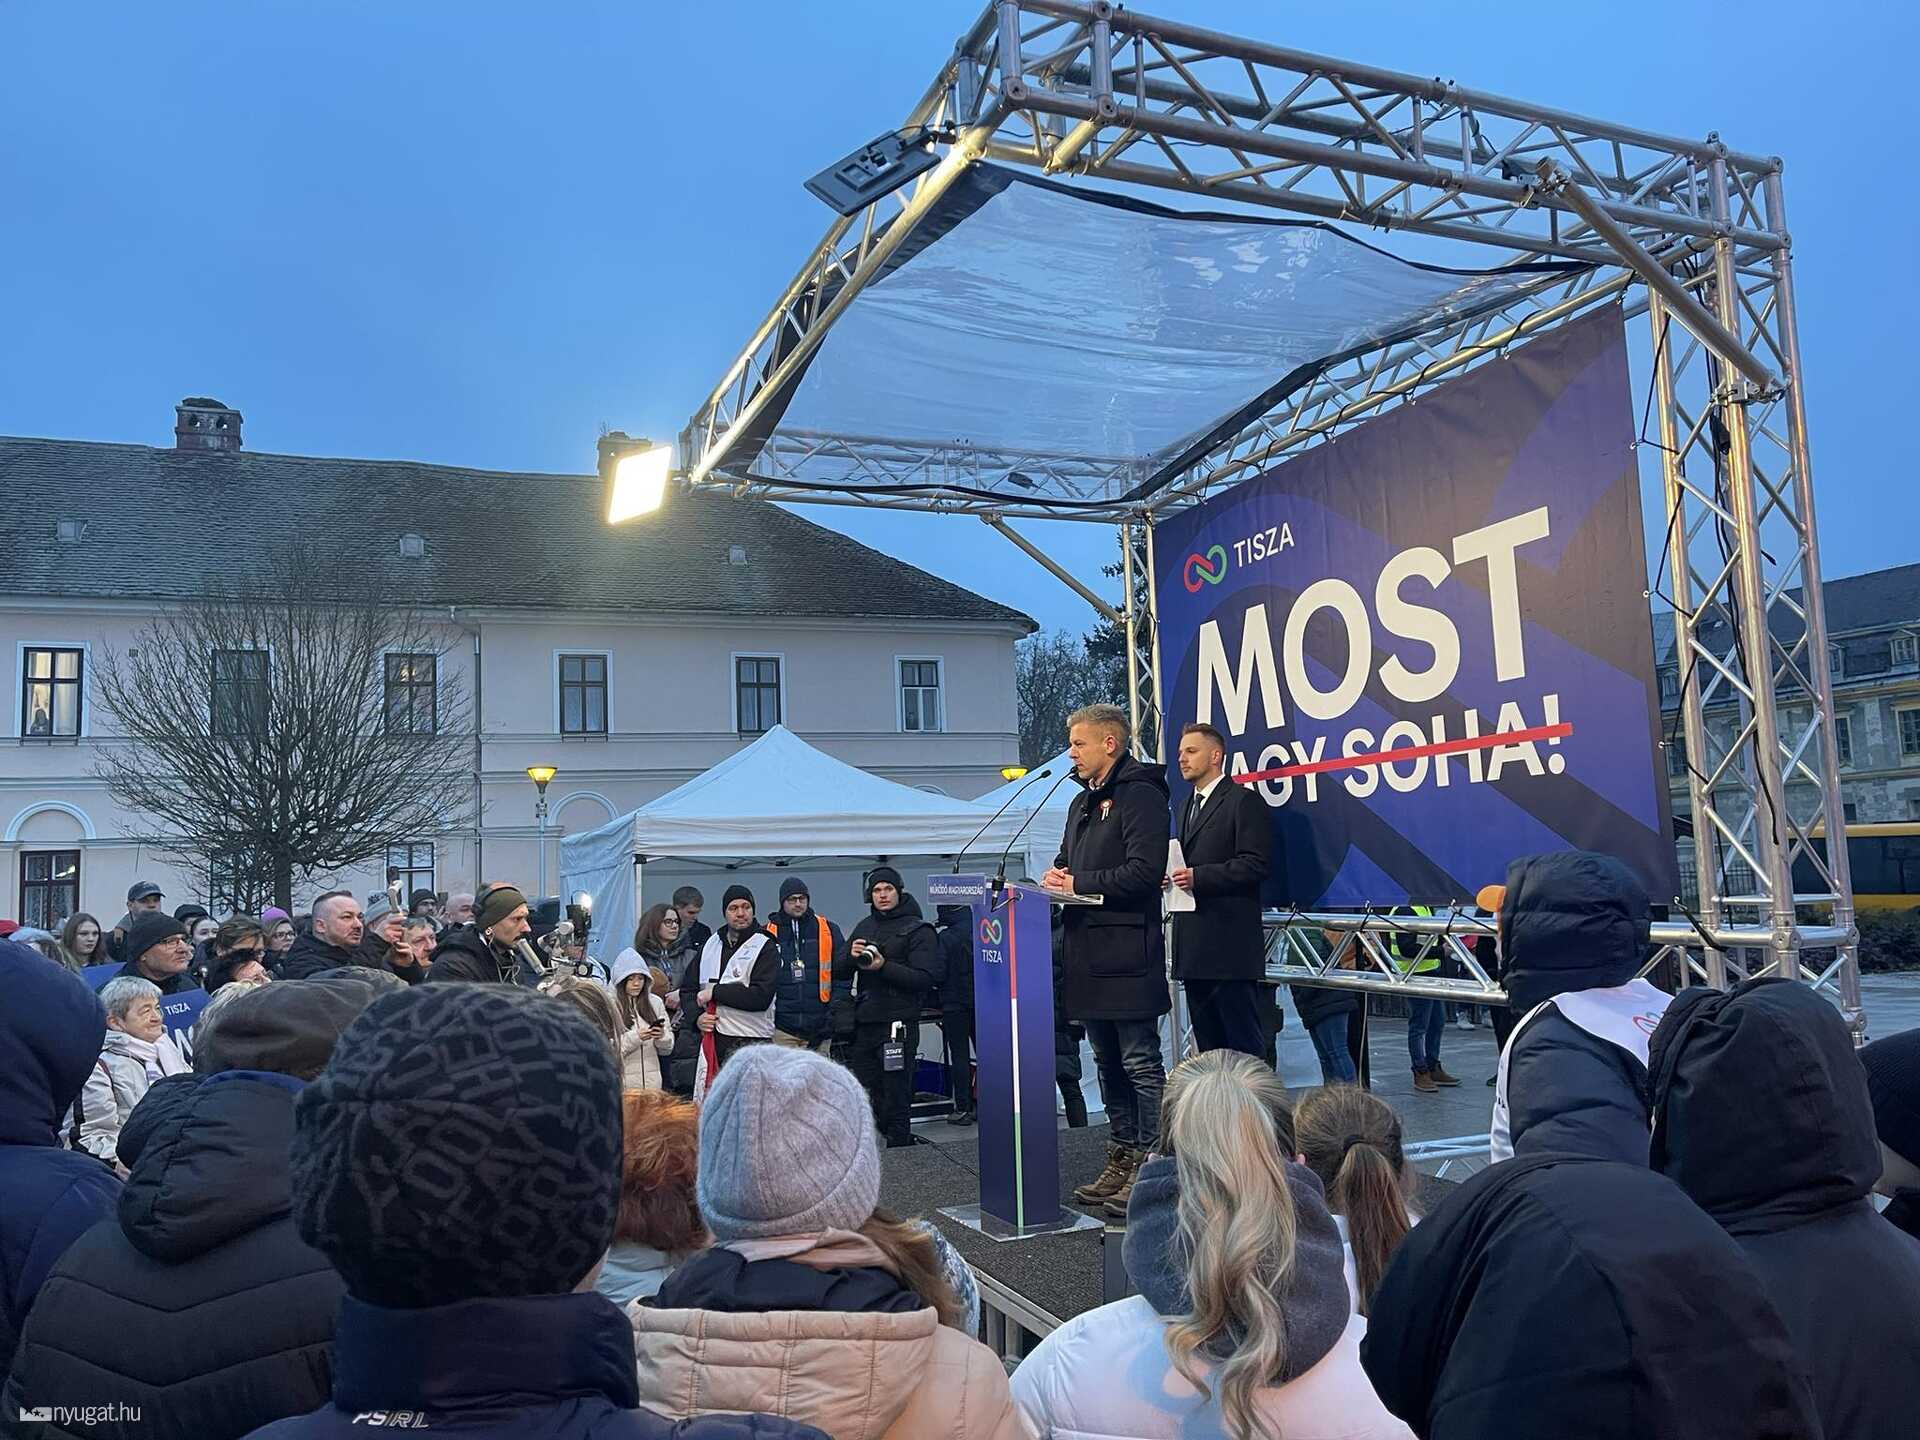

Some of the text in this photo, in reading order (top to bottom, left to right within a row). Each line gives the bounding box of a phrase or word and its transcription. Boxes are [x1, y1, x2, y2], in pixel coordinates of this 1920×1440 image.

[1233, 522, 1296, 568] TISZA
[1196, 506, 1550, 736] MOST
[1222, 694, 1567, 807] AGY SOHA!
[982, 949, 1003, 963] TISZA
[164, 1002, 191, 1016] TISZA
